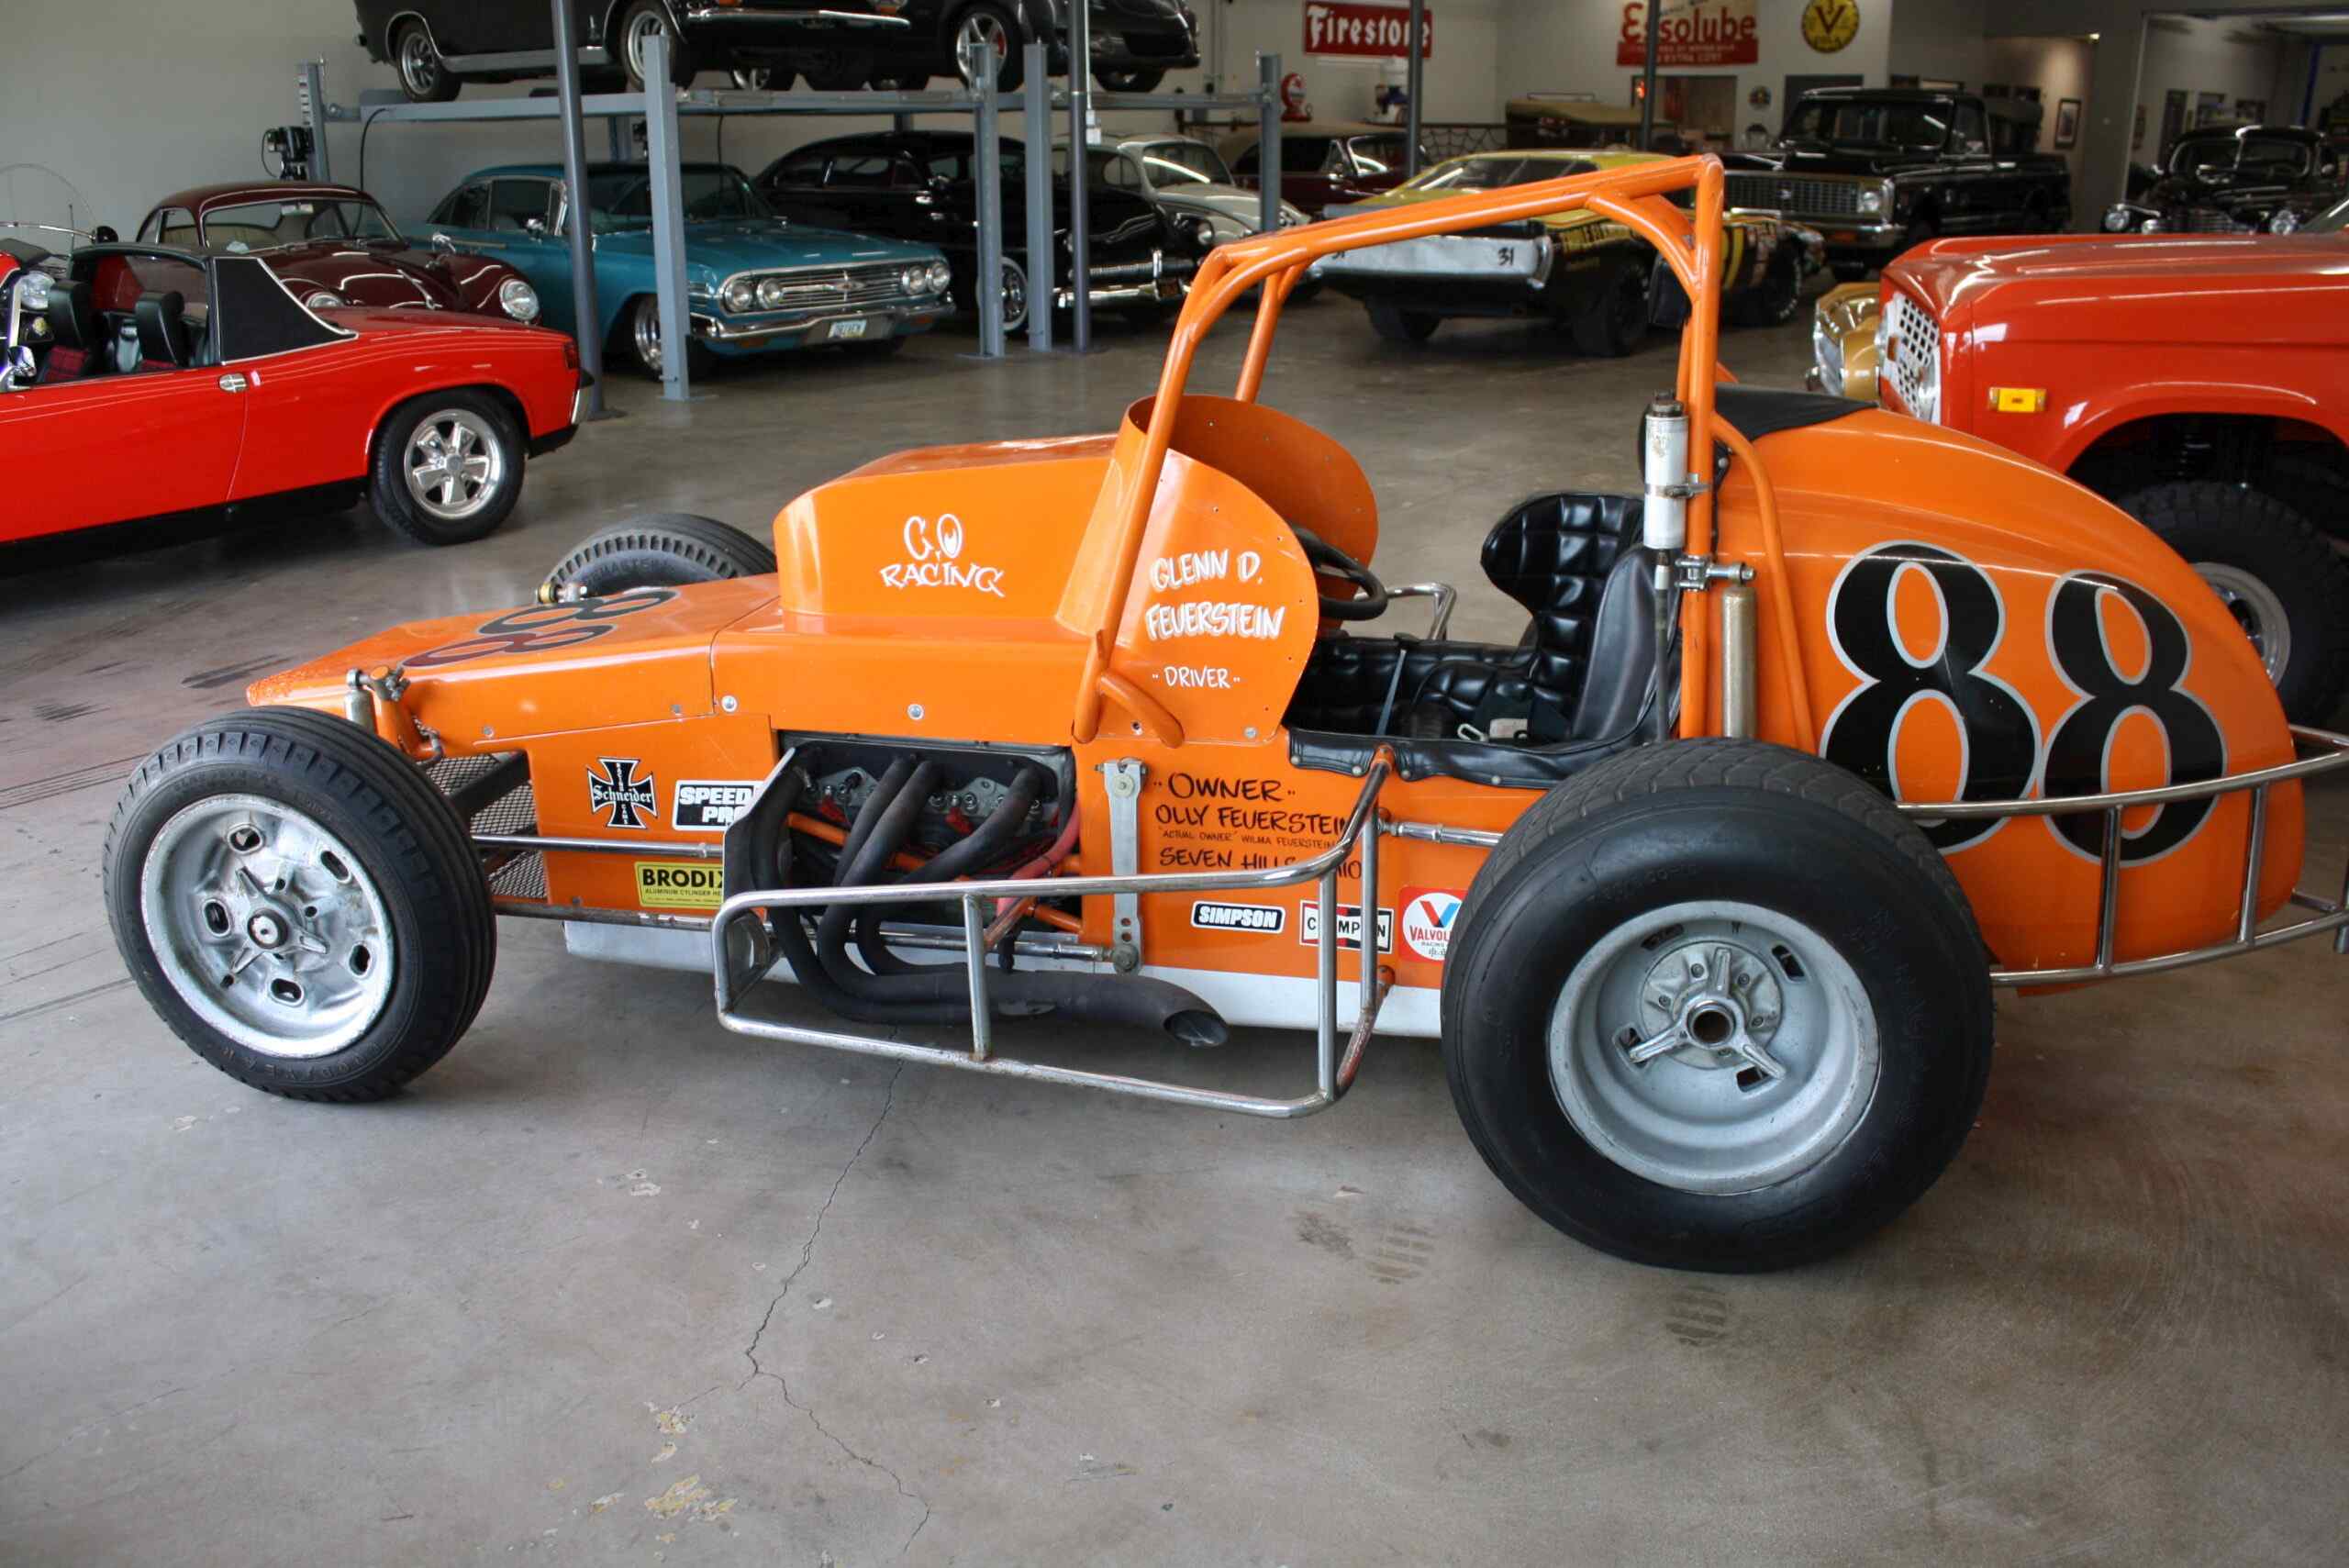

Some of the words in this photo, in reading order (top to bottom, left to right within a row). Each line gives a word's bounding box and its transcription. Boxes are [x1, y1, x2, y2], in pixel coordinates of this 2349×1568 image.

[1621, 3, 1756, 44] Esolube
[1497, 248, 1514, 266] 31
[879, 562, 1006, 597] RACING
[1151, 550, 1229, 592] GLENN
[1238, 551, 1264, 584] D.
[1145, 602, 1285, 639] FEUERSTEIN
[1819, 539, 2228, 868] 88
[593, 784, 652, 803] Schneider
[679, 786, 752, 805] SPEED
[1155, 804, 1210, 826] OLLY
[1159, 846, 1233, 867] SEVEN
[1198, 906, 1277, 929] SIMPSON
[1307, 917, 1386, 938] CMPN
[1409, 925, 1449, 941] VALVOL
